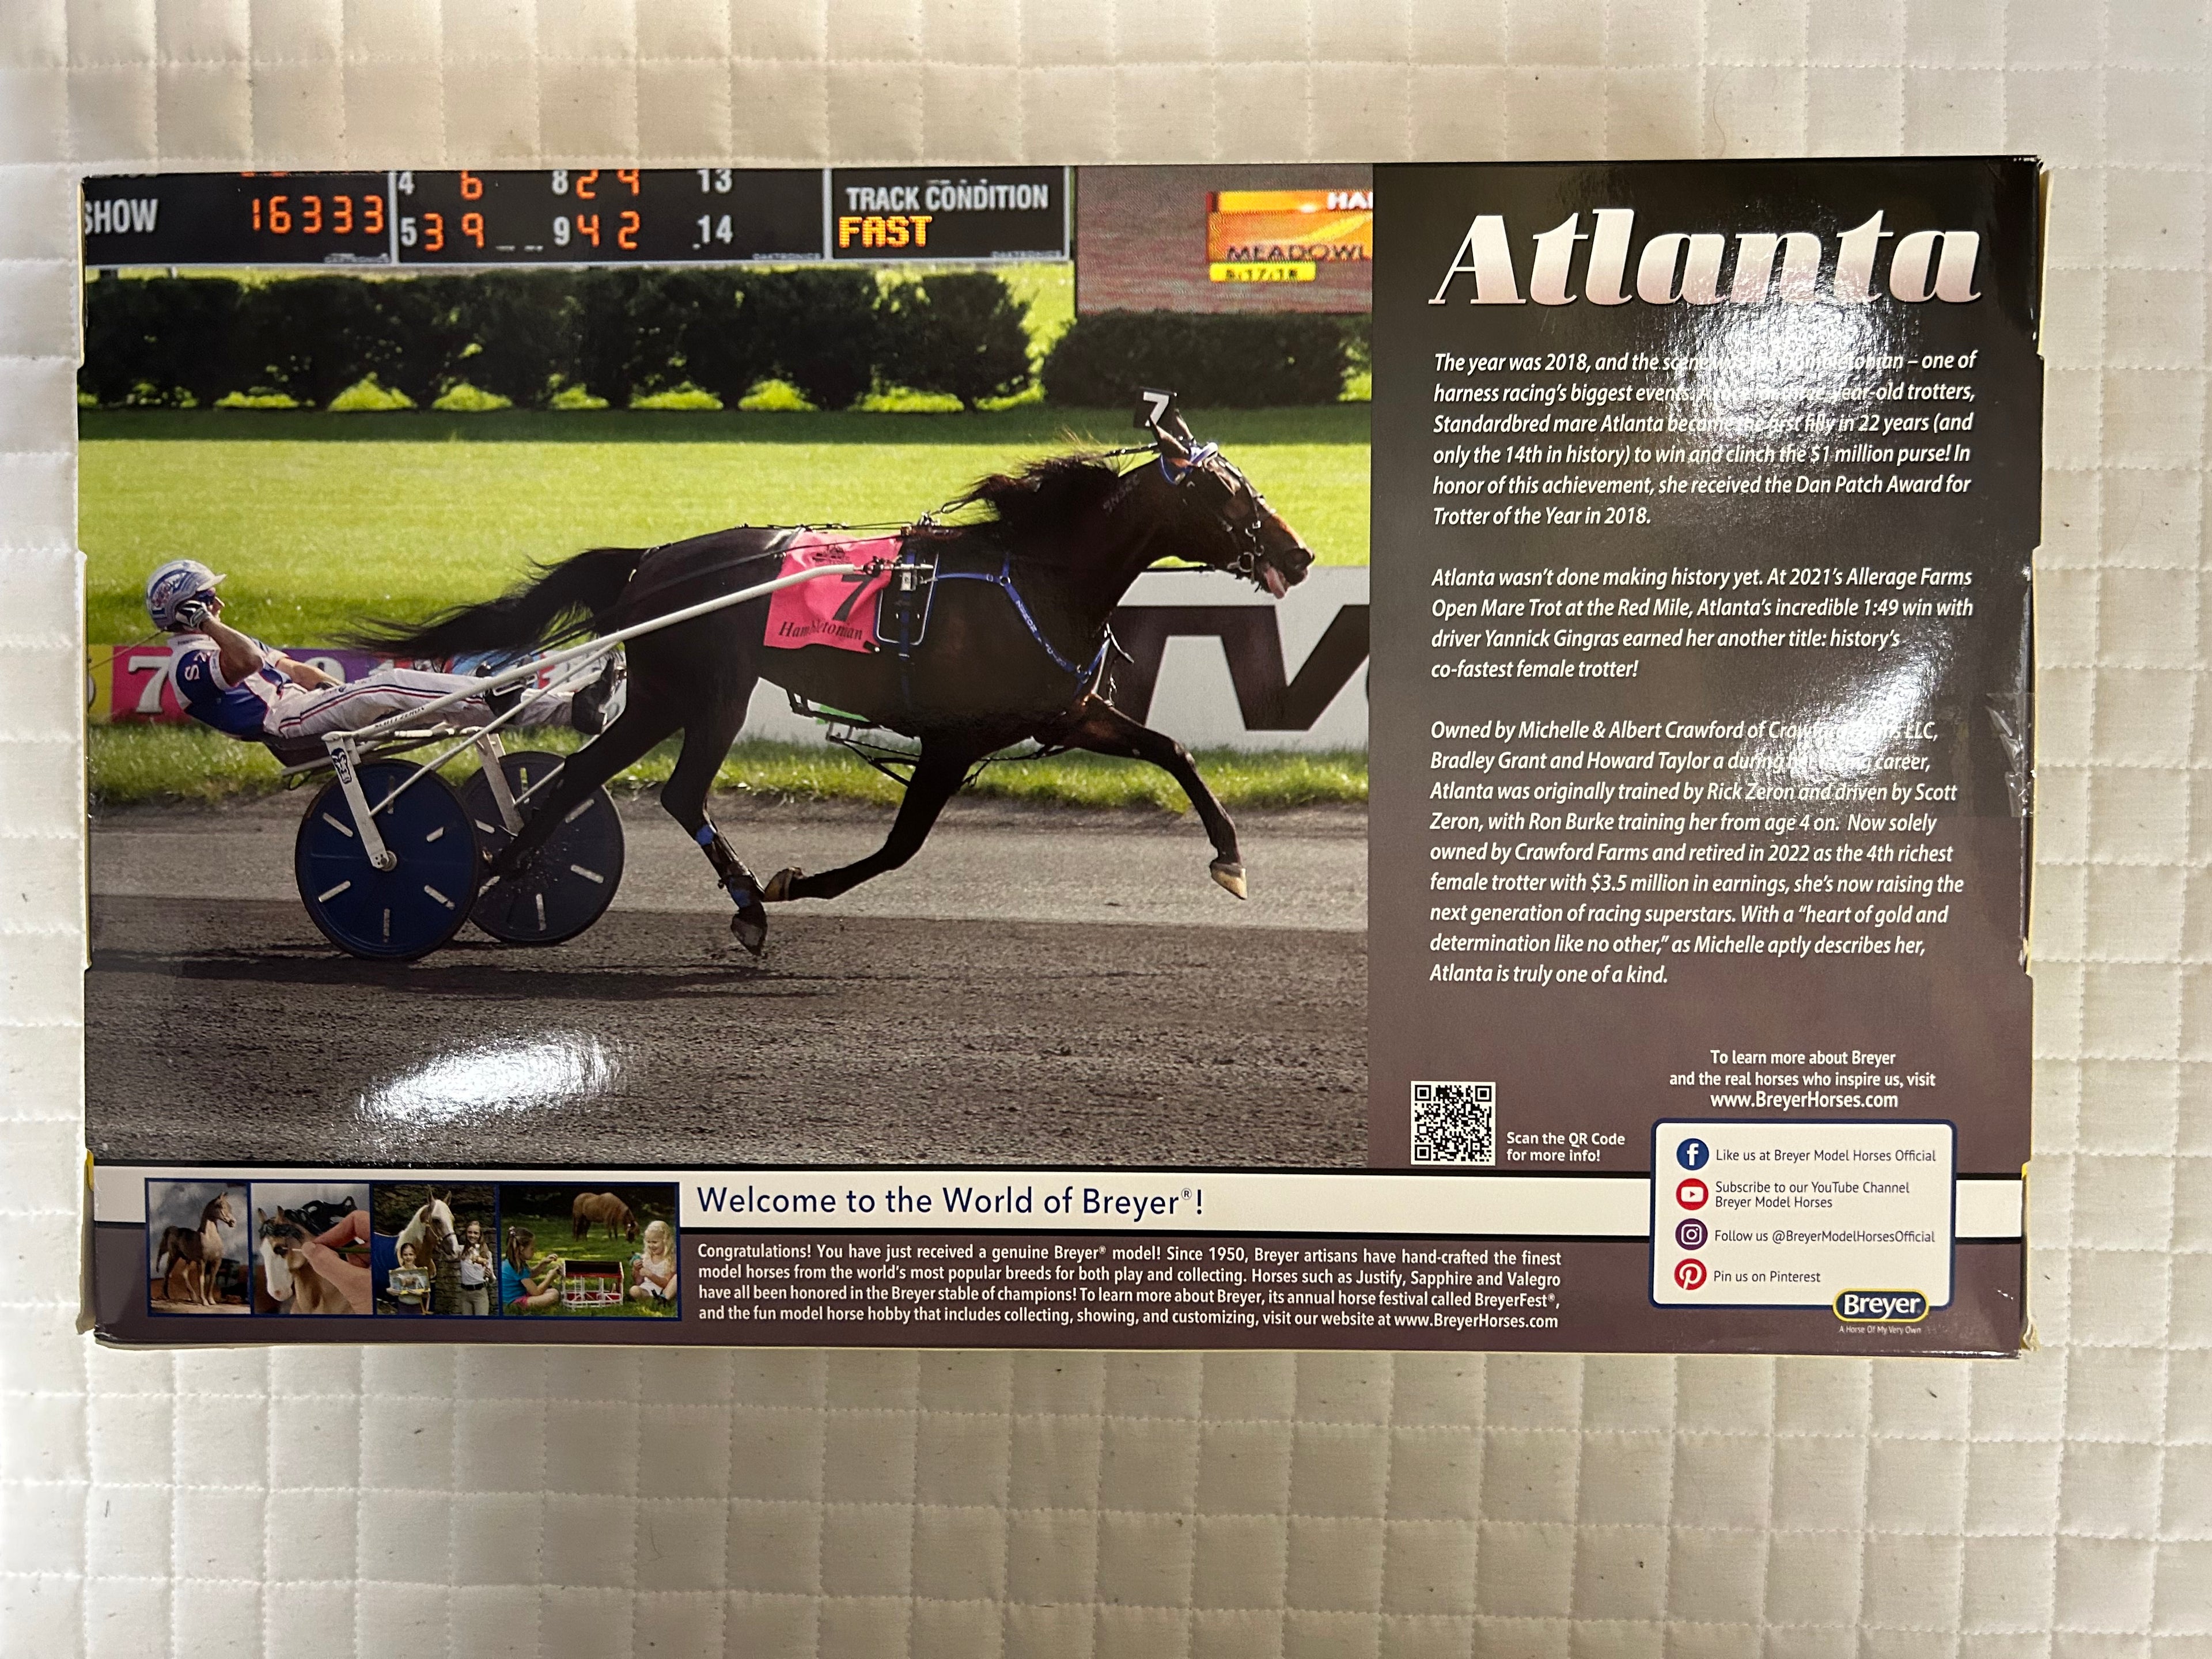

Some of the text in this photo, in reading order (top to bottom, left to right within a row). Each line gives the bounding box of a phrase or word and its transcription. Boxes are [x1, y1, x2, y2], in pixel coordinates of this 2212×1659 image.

[846, 184, 1049, 211] TRACK CONDITION
[1327, 192, 1373, 210] HA
[251, 195, 384, 234] 16333
[400, 217, 418, 246] 5
[553, 216, 571, 247] 9
[839, 216, 933, 248] FAST
[1429, 208, 1982, 305] Atlanta
[1143, 391, 1170, 427] 7
[1434, 506, 1650, 524] Trotter of the Year in 2018.
[1431, 567, 1972, 590] Atlanta wasn’t done making history yet. At 2021’s Allerage Farms
[832, 573, 879, 622] 7
[128, 656, 171, 713] 7
[1430, 905, 1468, 921] next
[1471, 904, 1563, 925] generation
[1567, 903, 1586, 921] of
[1588, 904, 1641, 926] racing
[1645, 907, 1736, 926] superstars.
[1742, 904, 1779, 922] With
[1783, 910, 1794, 922] a
[1855, 905, 1874, 922] of
[1875, 905, 1913, 927] gold
[1916, 905, 1949, 923] and
[1430, 963, 1667, 986] Atlanta is truly one of a kind.
[1710, 1050, 1896, 1067] To learn more about Breyer
[1670, 1071, 1936, 1089] and the real horses who inspire us, visit
[1710, 1090, 1898, 1111] www.BreyerHorses.com
[1507, 1132, 1625, 1147] Scan the QR Code
[1507, 1149, 1600, 1161] for more info!
[1717, 1149, 1936, 1164] Like us at Breyer Model Horses Official
[1716, 1181, 1910, 1193] Subscribe to our YouTube Channel
[697, 1185, 835, 1212] Welcome
[846, 1191, 874, 1213] to
[885, 1185, 931, 1213] the
[943, 1186, 1031, 1213] World
[1044, 1186, 1073, 1213] of
[1716, 1196, 1832, 1210] Breyer Model Horses
[1715, 1230, 1935, 1244] Follow us @BreyerModelHorsesOfficial
[698, 1243, 810, 1261] Congratulations!
[817, 1244, 842, 1257] You
[849, 1244, 881, 1257] have
[885, 1246, 912, 1262] just
[918, 1244, 973, 1258] received
[979, 1248, 986, 1258] a
[992, 1248, 1048, 1262] genuine
[1113, 1245, 1160, 1260] model!
[1167, 1247, 1203, 1260] Since
[1209, 1247, 1248, 1263] 1950,
[1255, 1248, 1299, 1266] Breyer
[1304, 1248, 1357, 1262] artisans
[1363, 1248, 1396, 1263] have
[1402, 1249, 1488, 1264] hand-crafted
[1494, 1250, 1516, 1264] the
[1521, 1250, 1561, 1265] finest
[1714, 1271, 1820, 1282] Pin us on Pinterest
[699, 1305, 1558, 1331] and the fun model horse hobby that includes collecting, showing, and customizing, visit our website at www.BreyerHorses.com
[1844, 1294, 1921, 1319] Breyer
[1846, 1325, 1865, 1334] Horse
[1877, 1326, 1887, 1335] My
[1888, 1326, 1903, 1334] Very
[1905, 1326, 1921, 1334] Own
